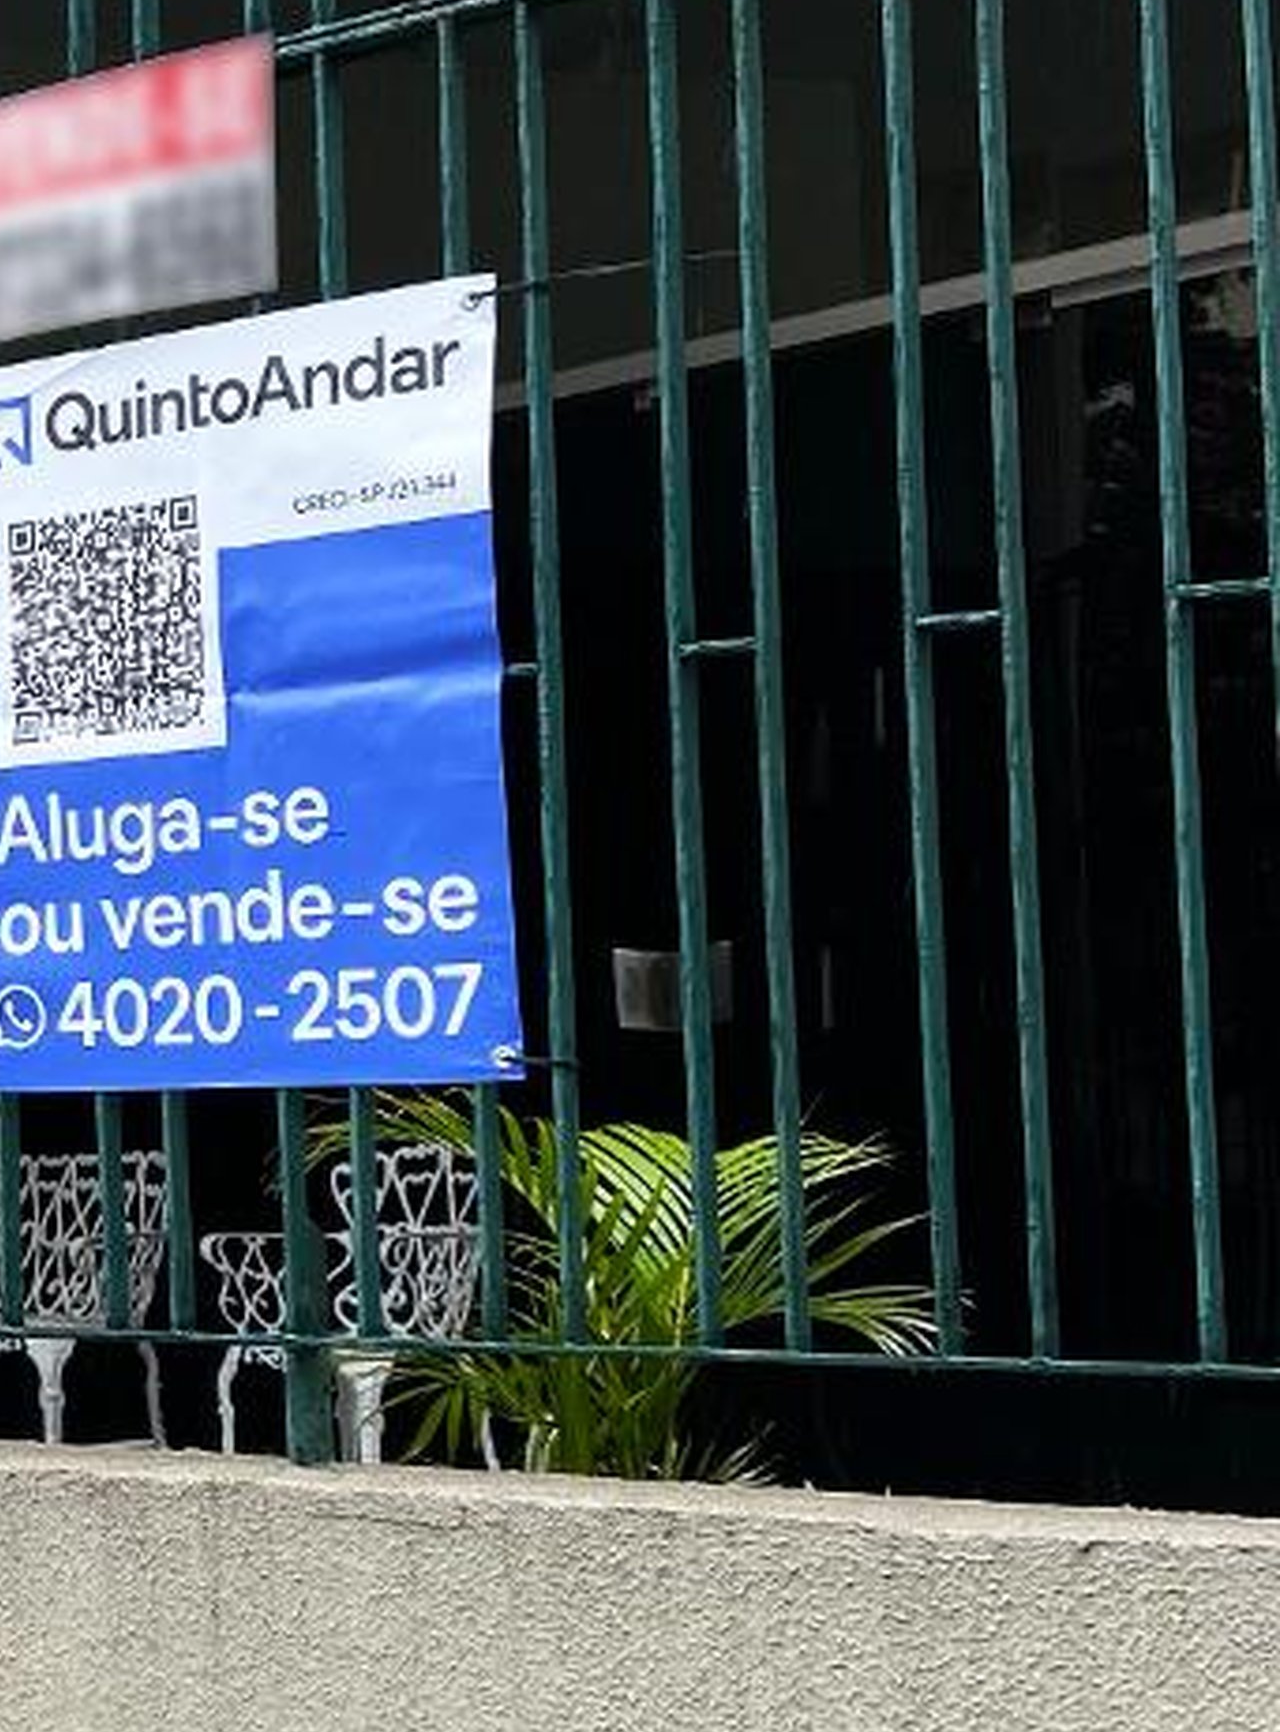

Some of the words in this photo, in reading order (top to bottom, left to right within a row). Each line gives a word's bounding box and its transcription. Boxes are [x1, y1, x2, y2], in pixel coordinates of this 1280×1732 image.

[44, 337, 461, 453] QuintoAndar
[0, 899, 85, 955] ou
[101, 871, 480, 951] vende-se
[57, 963, 483, 1049] 4020-2507
